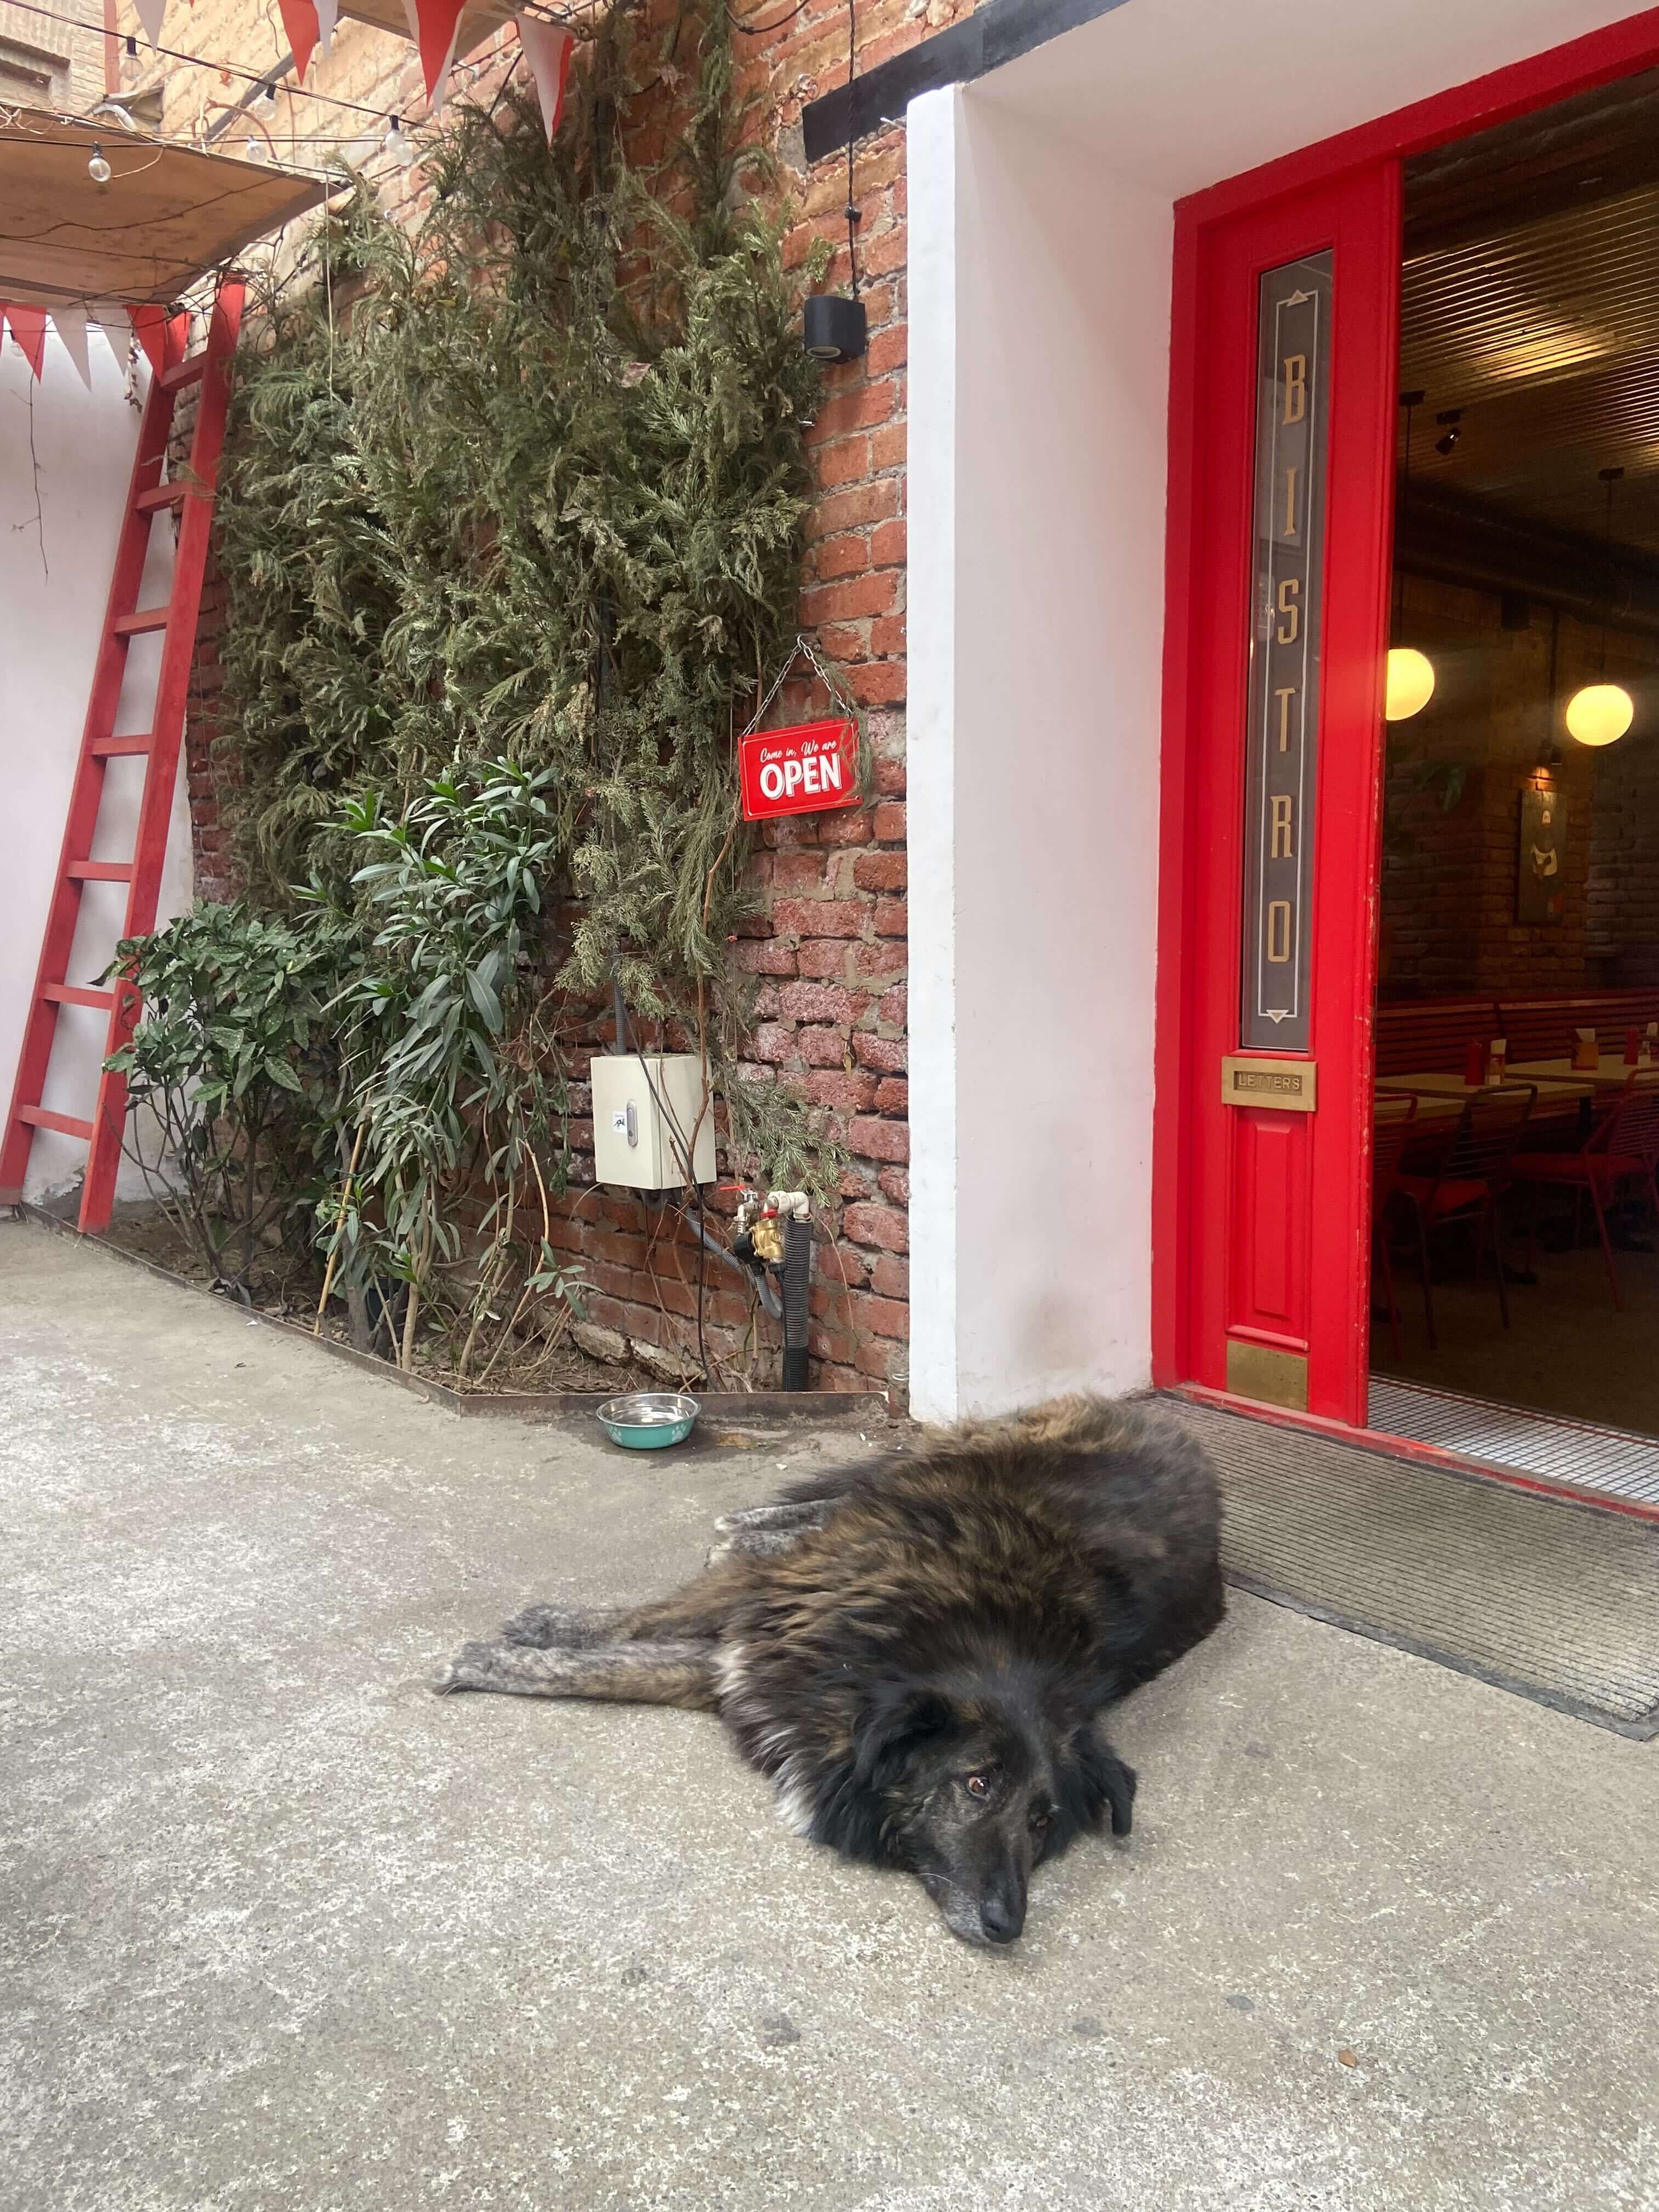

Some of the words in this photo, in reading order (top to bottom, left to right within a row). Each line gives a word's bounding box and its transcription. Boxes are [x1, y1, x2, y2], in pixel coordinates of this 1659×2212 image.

[1267, 353, 1306, 962] BISTRO
[760, 748, 782, 763] Come
[800, 740, 819, 756] We
[822, 741, 837, 751] are
[760, 753, 842, 800] OPEN
[1238, 1074, 1300, 1090] LETTERS
